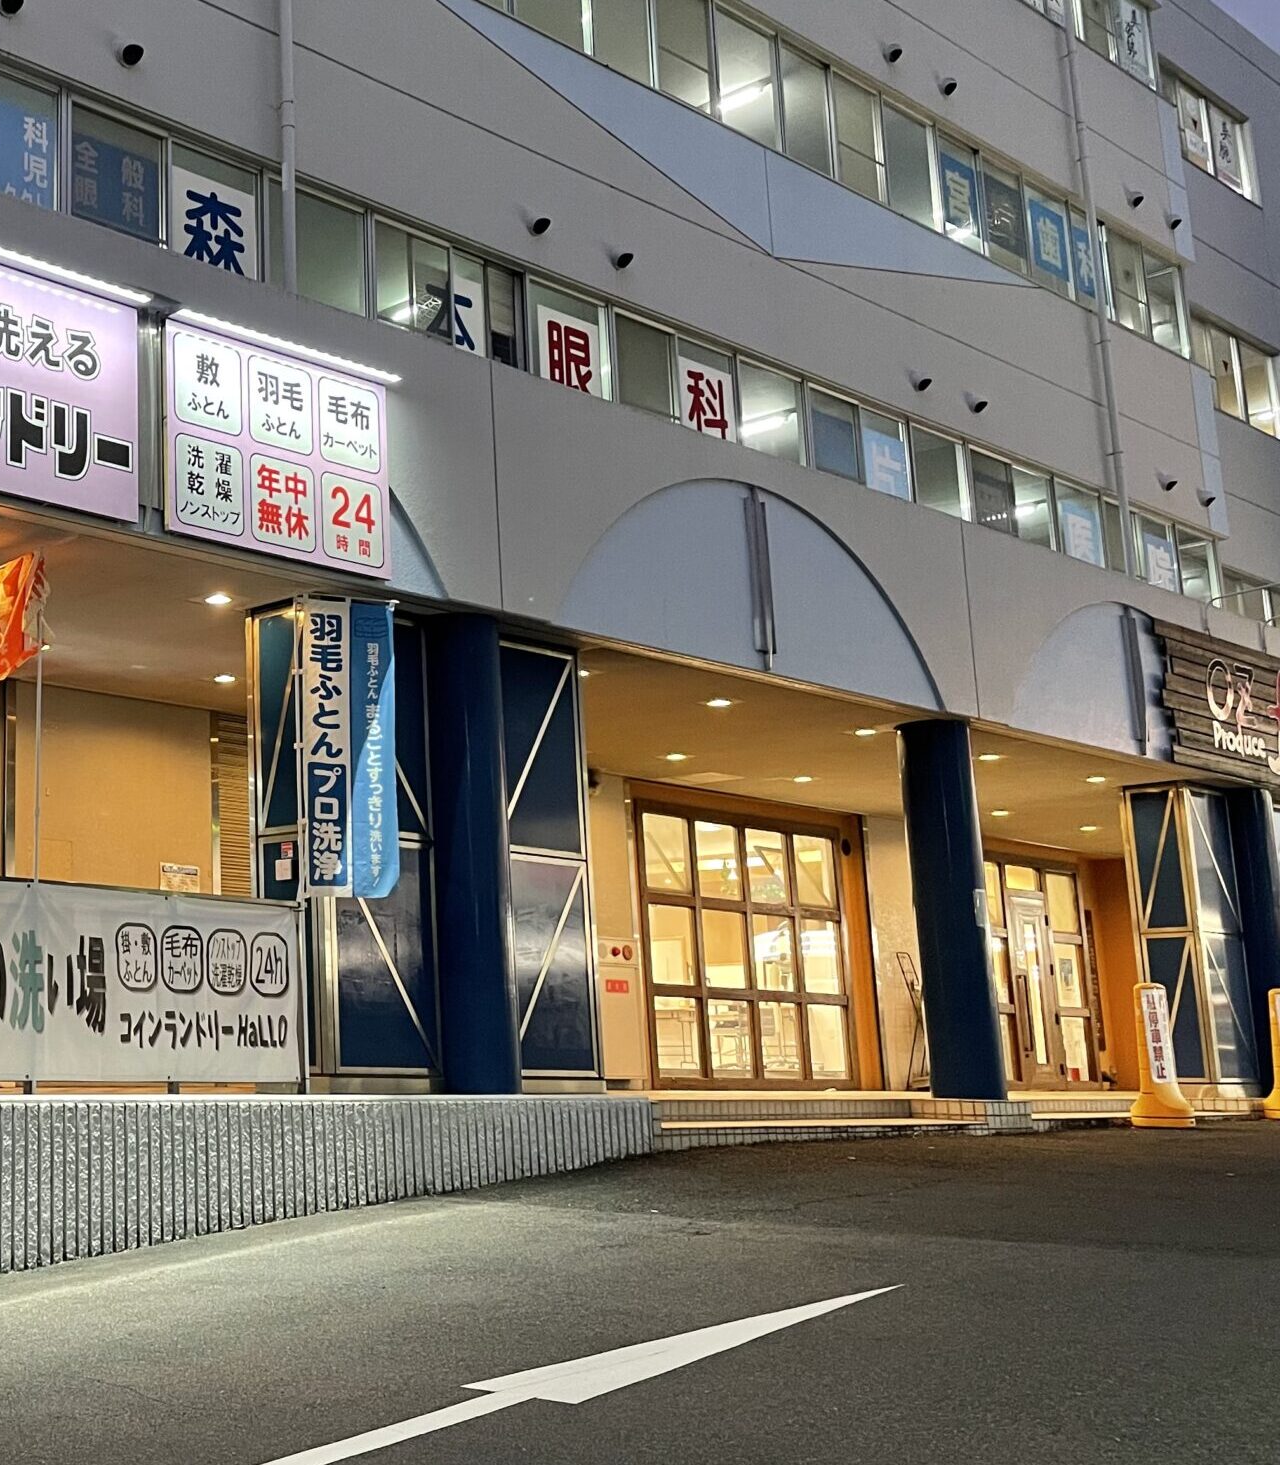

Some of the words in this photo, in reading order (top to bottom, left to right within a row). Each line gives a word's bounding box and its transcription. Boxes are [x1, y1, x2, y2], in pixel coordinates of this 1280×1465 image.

[184, 189, 245, 276] 森
[547, 320, 592, 394] 眼
[687, 370, 728, 440] 科
[196, 353, 220, 388] 敷
[187, 393, 229, 420] ふとん
[257, 371, 304, 412] 羽毛
[262, 414, 301, 440] ふとん
[327, 395, 370, 430] 毛布
[187, 444, 232, 476] 洗濯
[323, 432, 377, 459] カーペット
[187, 471, 232, 503] 乾燥
[257, 463, 307, 505] 年中
[180, 500, 240, 525] ノンストップ
[258, 498, 309, 541] 無休
[331, 485, 376, 534] 24
[336, 533, 371, 557] 時間
[309, 613, 343, 759] 羽毛ふとん
[1212, 720, 1267, 759] Produce
[312, 767, 343, 881] プロ洗浄
[165, 932, 199, 959] 毛布
[210, 937, 242, 960] ノンストップ
[123, 960, 152, 983] ふとん
[168, 961, 199, 986] カーペット
[255, 945, 283, 985] 24h
